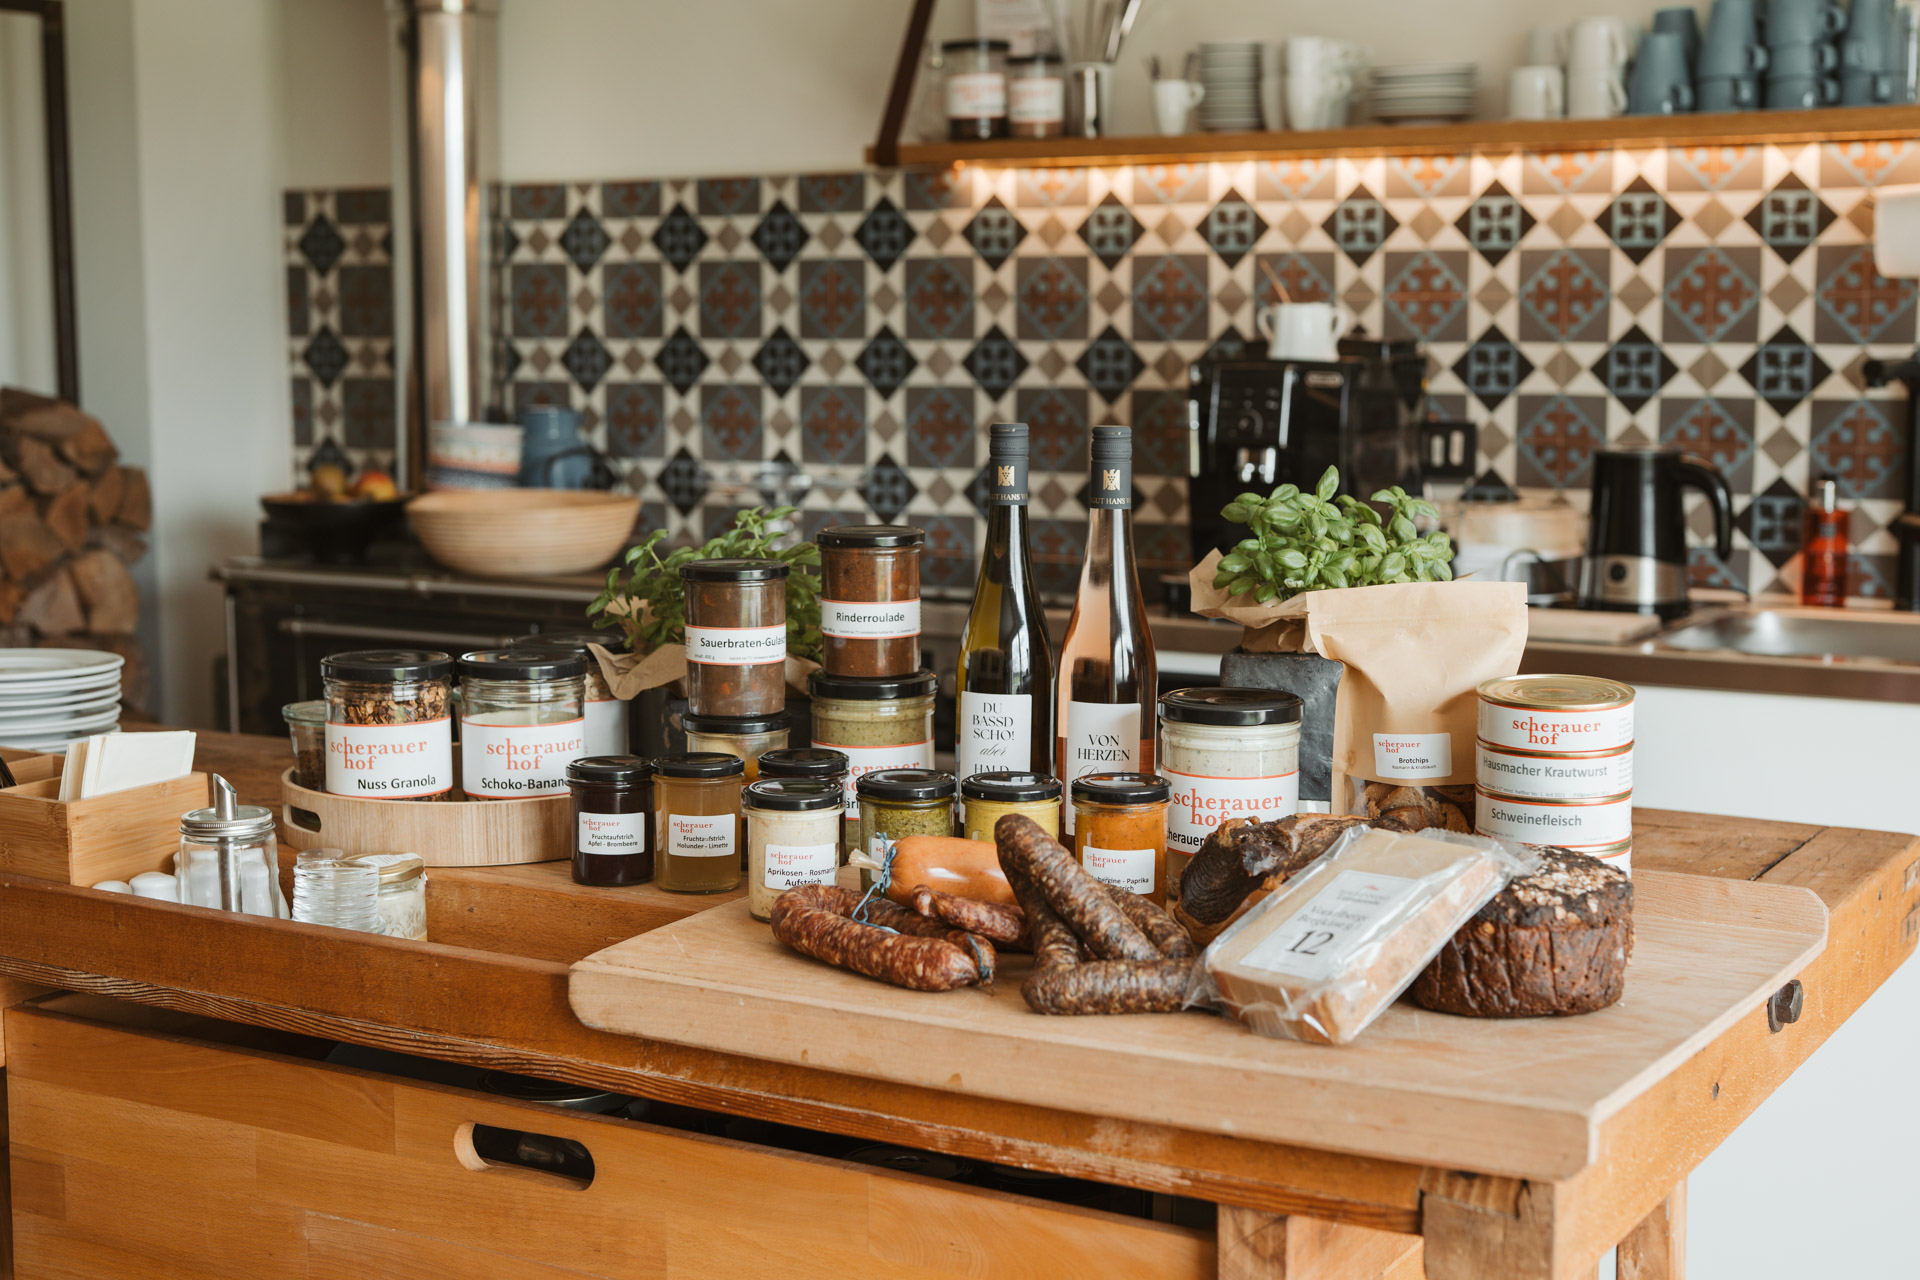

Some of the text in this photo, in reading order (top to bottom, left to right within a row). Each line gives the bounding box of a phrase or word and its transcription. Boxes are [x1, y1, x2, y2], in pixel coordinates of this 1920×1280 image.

[1001, 493, 1021, 501] HANS
[1106, 497, 1126, 505] HANS
[836, 612, 905, 623] Rinderroulade
[983, 702, 1003, 713] DU
[972, 714, 1014, 728] BASSD
[1512, 716, 1601, 734] scherauer
[973, 728, 1015, 741] SCHO!
[1088, 734, 1120, 747] VON
[1528, 733, 1560, 745] hof
[331, 736, 428, 755] scherauer
[487, 738, 582, 756] scherauer
[980, 742, 1008, 757] aber
[1378, 739, 1421, 748] scherauer
[1078, 748, 1131, 762] HERZEN
[1398, 757, 1429, 765] Brotchips
[344, 755, 377, 770] hof
[506, 755, 543, 771] hof
[1483, 756, 1541, 777] Hausmacher
[1544, 765, 1608, 778] Krautwurst
[358, 774, 436, 790] Nuss Granola
[1173, 788, 1282, 811] scherauer
[582, 818, 621, 827] scherauer
[1190, 810, 1230, 827] hof
[1491, 808, 1582, 826] Schweinefleisch
[673, 820, 713, 829] scherauer
[770, 851, 814, 860] scherauer
[1086, 853, 1127, 864] scherauer
[767, 867, 803, 877] Aprikosen
[1126, 877, 1149, 885] Paprika
[1286, 930, 1335, 956] 12
